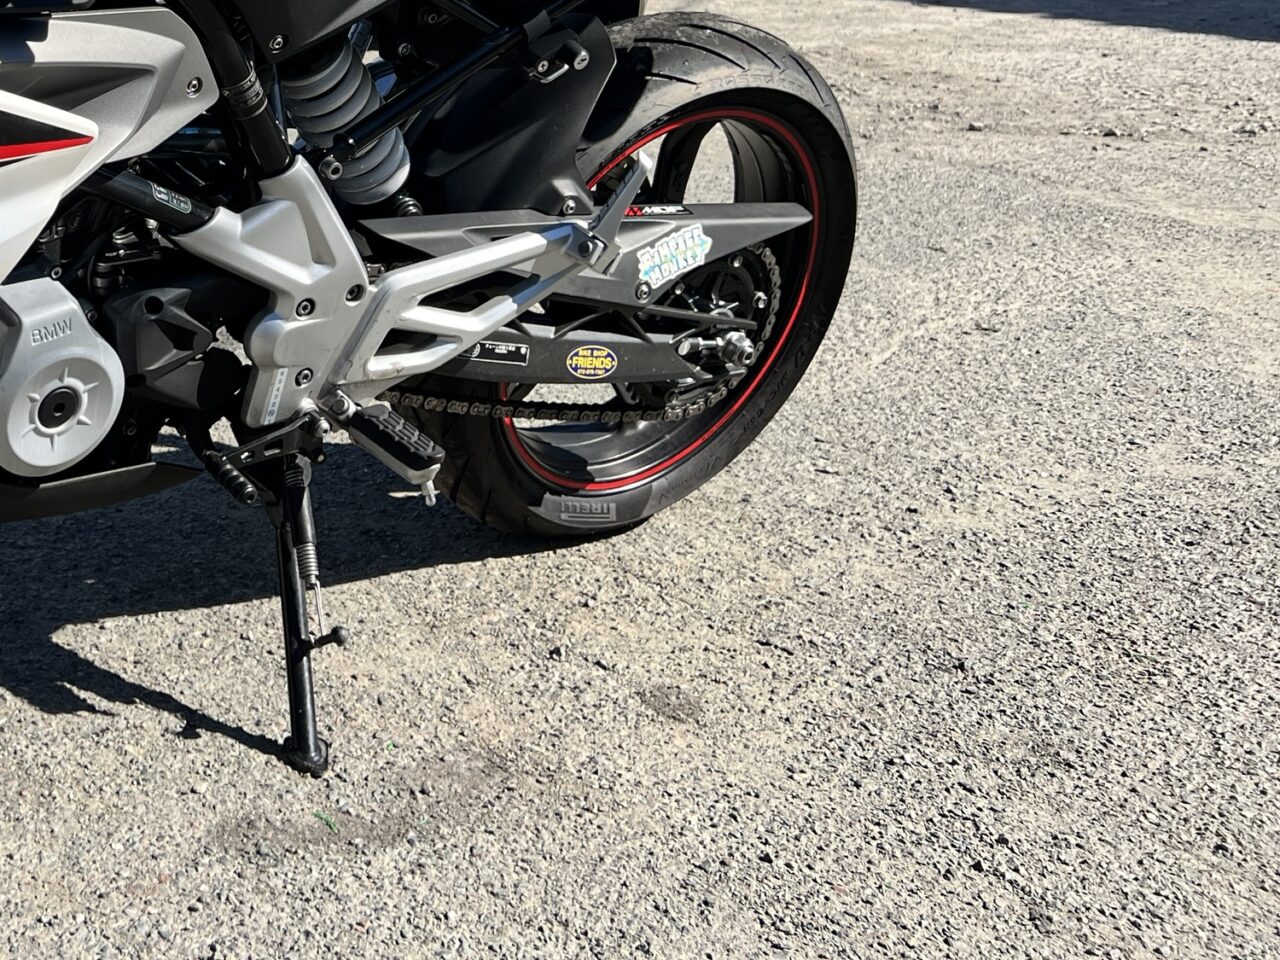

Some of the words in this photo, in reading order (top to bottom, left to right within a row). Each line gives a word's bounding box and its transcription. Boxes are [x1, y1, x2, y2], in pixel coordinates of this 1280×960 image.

[31, 317, 72, 346] BMW
[572, 356, 612, 369] FRIENDS
[561, 502, 616, 521] PIRELLI
